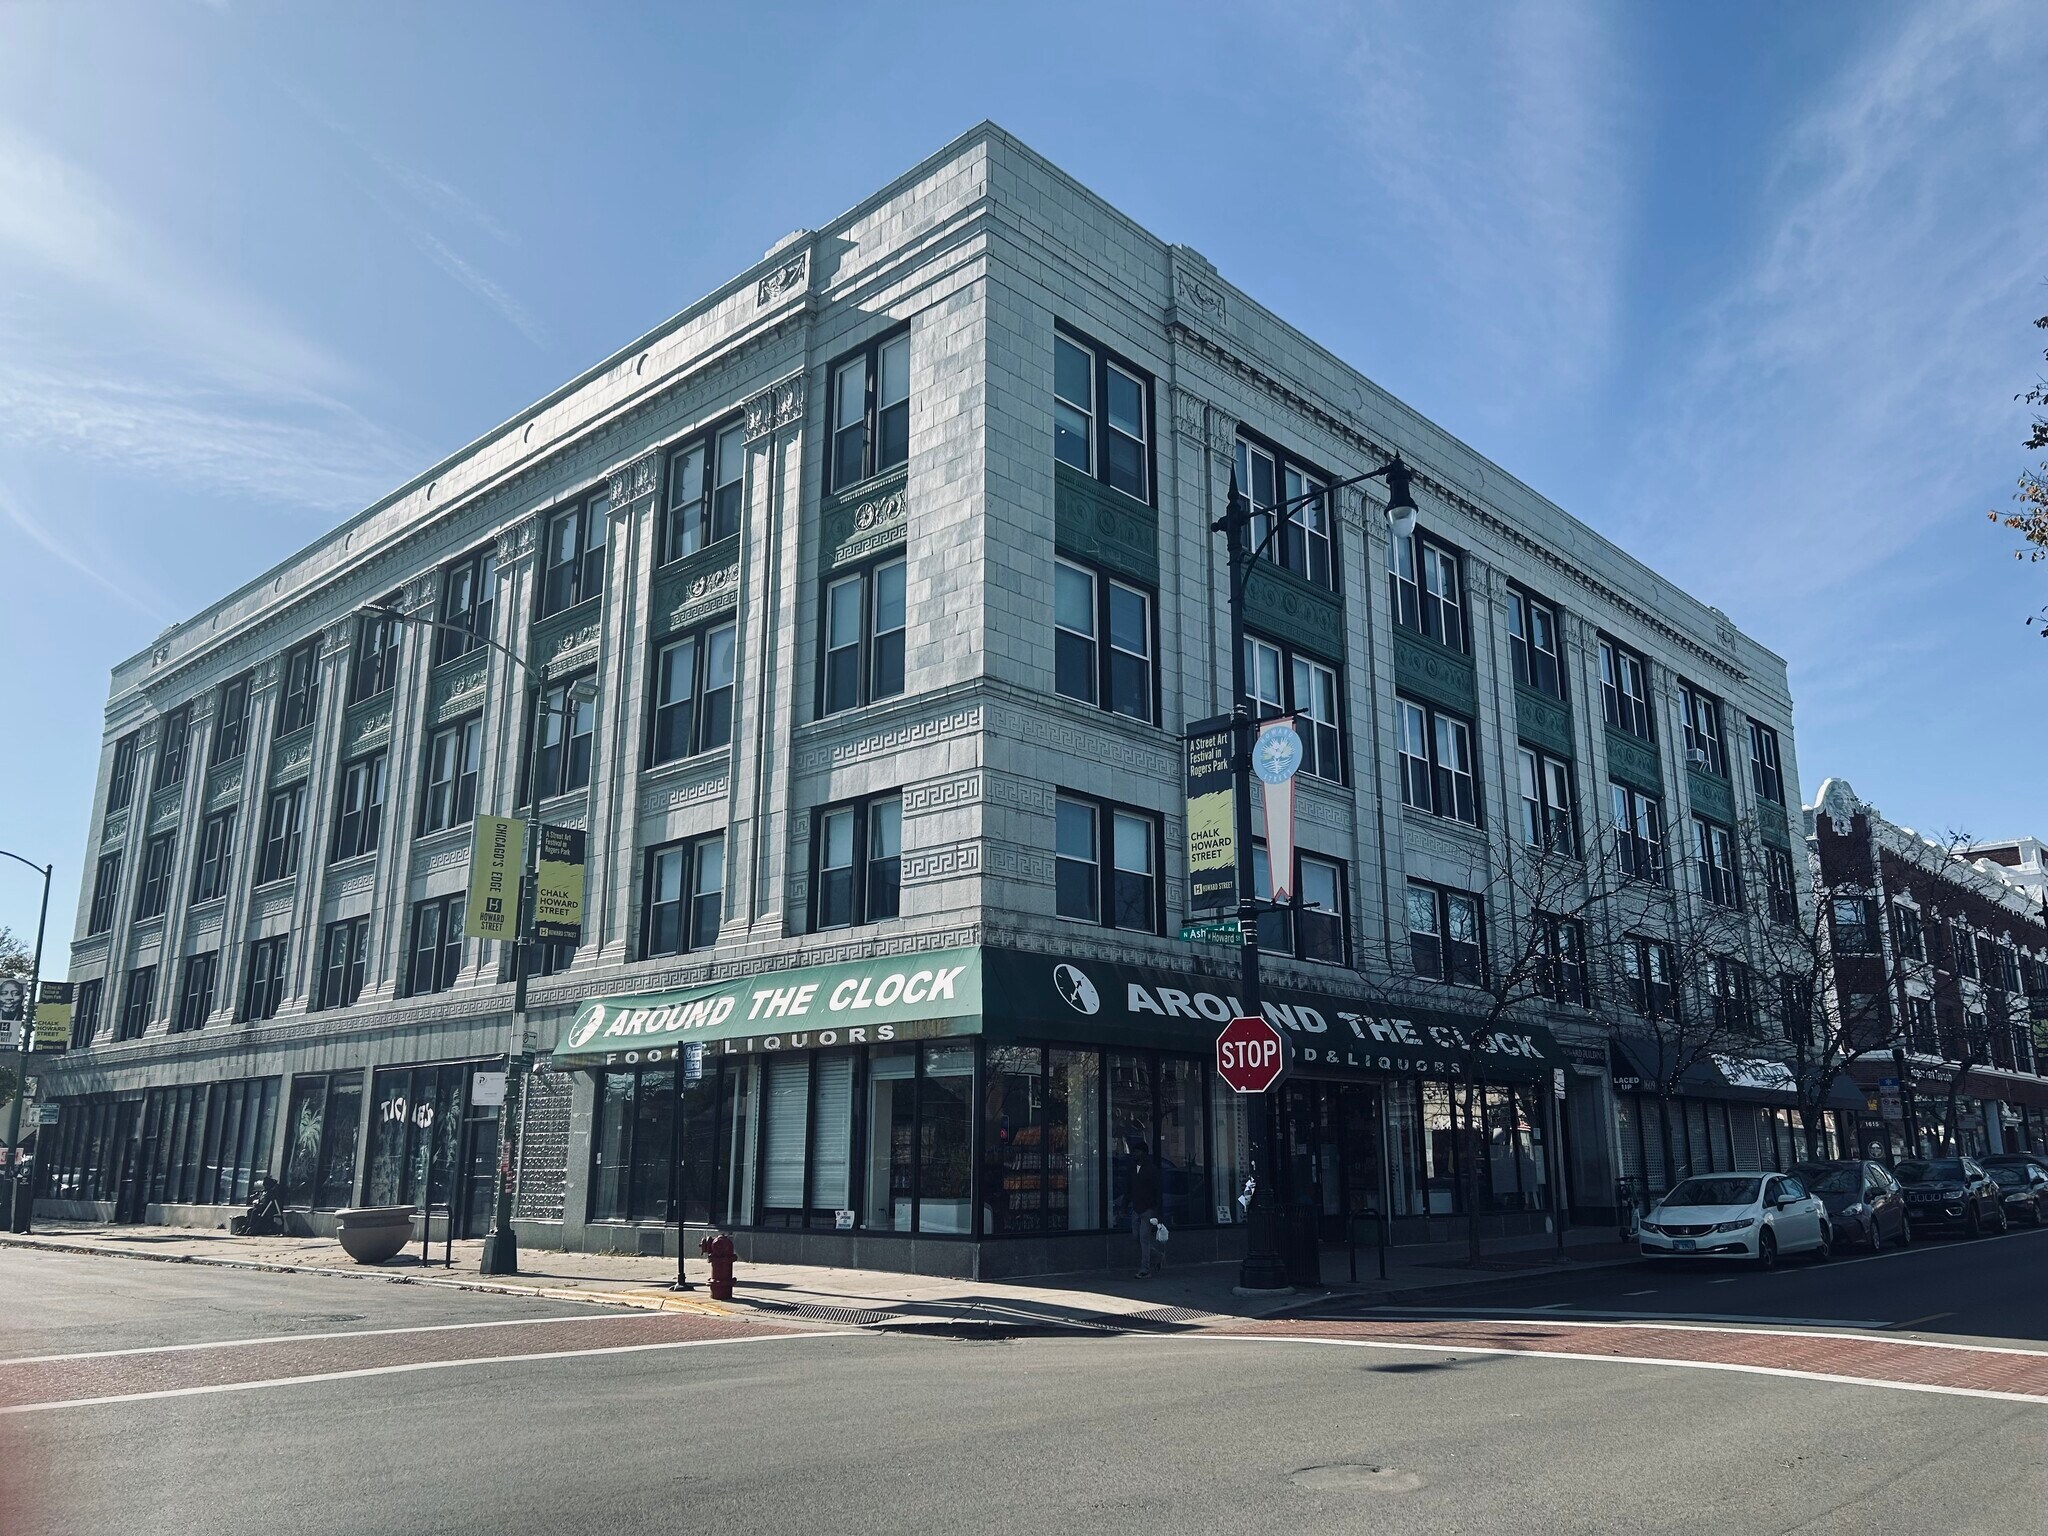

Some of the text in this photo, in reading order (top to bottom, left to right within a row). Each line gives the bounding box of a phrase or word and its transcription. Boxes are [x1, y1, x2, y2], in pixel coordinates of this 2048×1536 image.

[1190, 733, 1228, 752] A Street Art
[1190, 747, 1222, 764] Festival in
[1190, 759, 1228, 777] Rogers Park
[550, 831, 563, 840] Street
[1191, 828, 1220, 841] CHALK
[1191, 837, 1232, 852] HOWARD
[489, 823, 508, 893] CHICAGO'S EDGE
[560, 848, 570, 856] Park
[1191, 849, 1222, 862] STREET
[1202, 883, 1218, 892] HOWARD
[1218, 881, 1233, 890] STREET
[540, 889, 569, 898] CHALK
[540, 897, 579, 909] HOWARD
[480, 912, 505, 923] HOWARD
[539, 906, 570, 916] STREET
[480, 921, 503, 932] STREET
[1190, 925, 1225, 939] Ashd
[1212, 932, 1235, 943] Howard
[602, 965, 967, 1038] AROUND THE CLOCK
[1336, 1011, 1424, 1046] THE
[724, 1024, 895, 1054] LIQUORS
[1221, 1039, 1277, 1069] STOP
